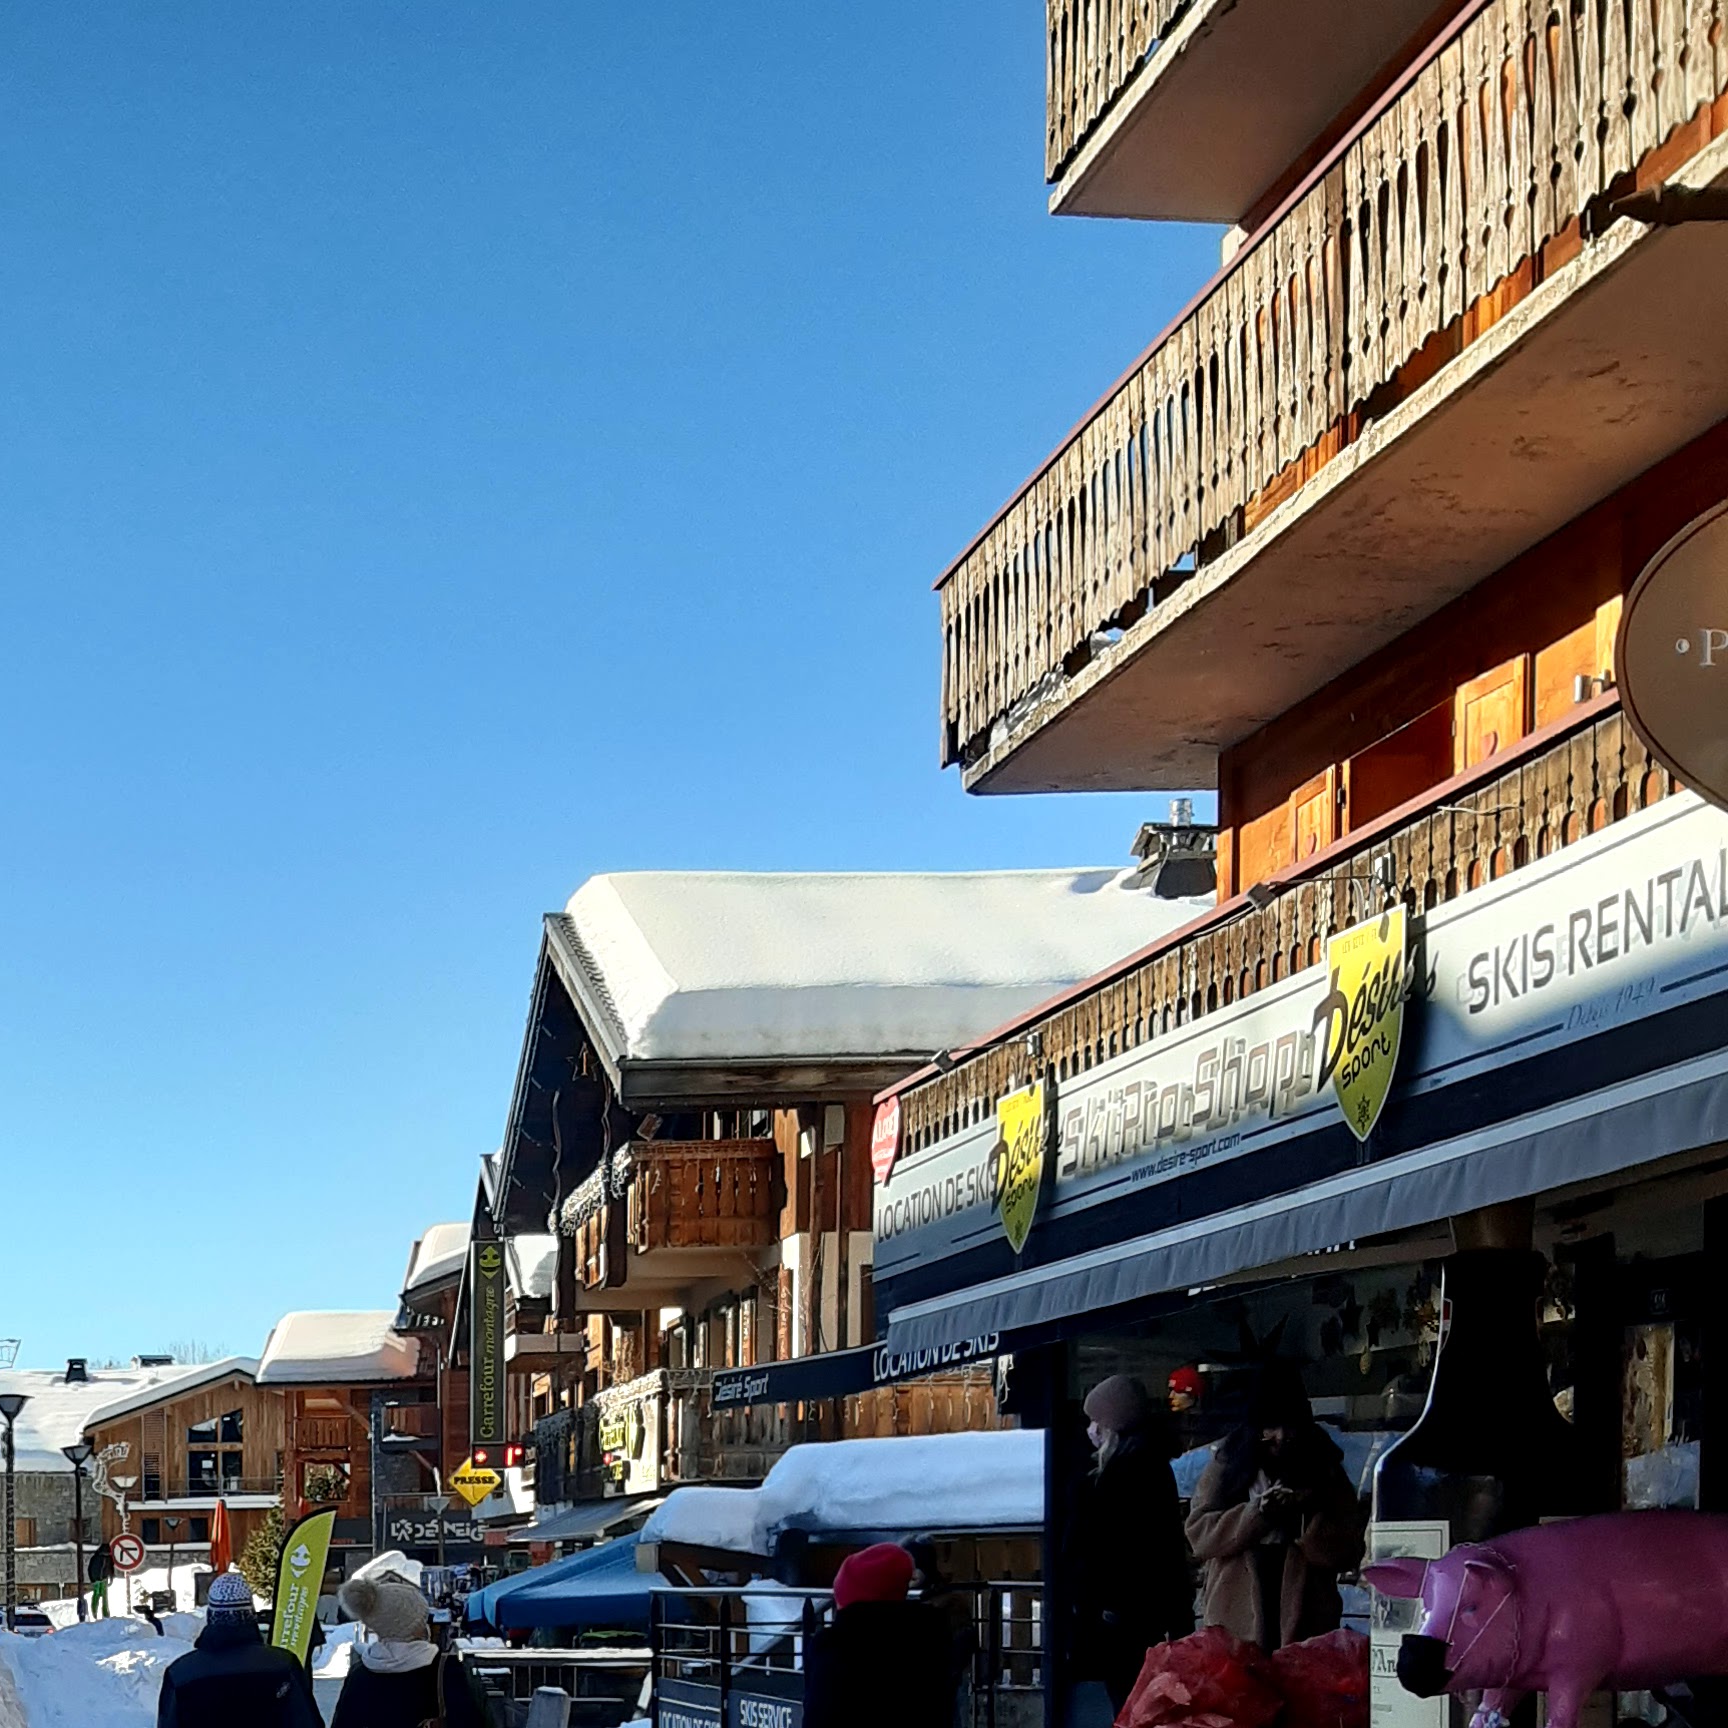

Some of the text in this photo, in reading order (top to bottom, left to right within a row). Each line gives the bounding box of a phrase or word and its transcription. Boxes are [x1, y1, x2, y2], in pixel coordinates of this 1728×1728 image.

[1468, 923, 1555, 1015] SKIS
[1341, 1031, 1392, 1091] sport
[877, 1181, 943, 1244] LOCATION
[945, 1172, 964, 1216] DE
[1005, 1176, 1036, 1215] sport
[479, 1285, 501, 1438] Carrefour montagne
[744, 1373, 770, 1403] Sport
[453, 1475, 495, 1485] PRESSE
[740, 1699, 758, 1728] SKIS
